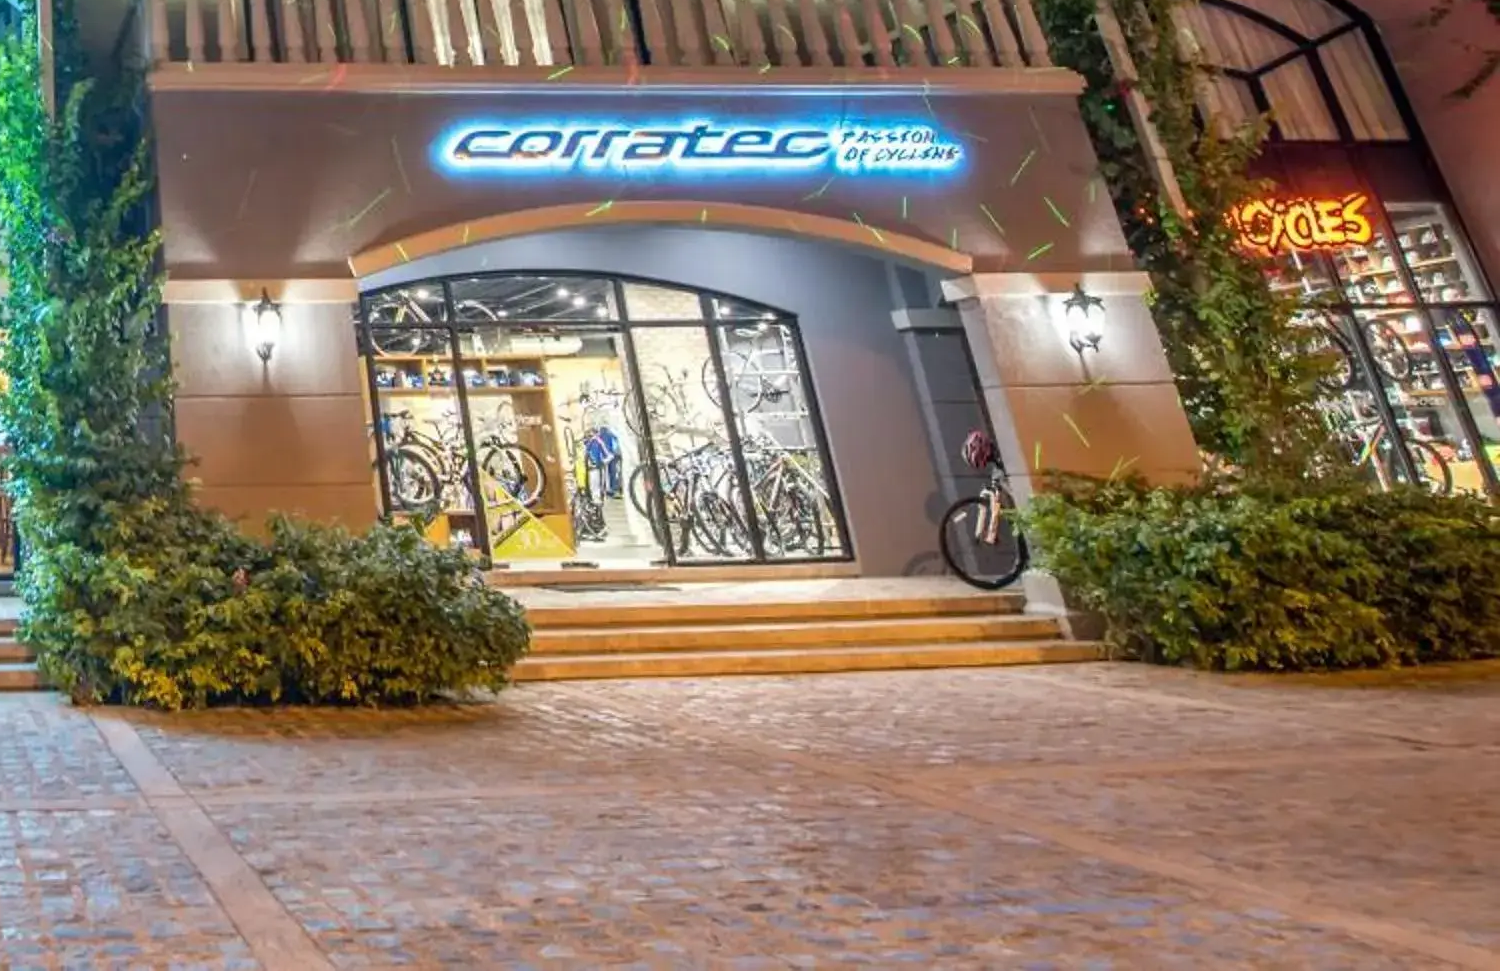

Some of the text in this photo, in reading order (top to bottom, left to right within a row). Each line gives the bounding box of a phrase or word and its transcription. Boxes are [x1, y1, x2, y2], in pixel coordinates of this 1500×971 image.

[453, 124, 829, 160] corratec
[841, 130, 936, 144] PASSION
[844, 146, 870, 162] OF
